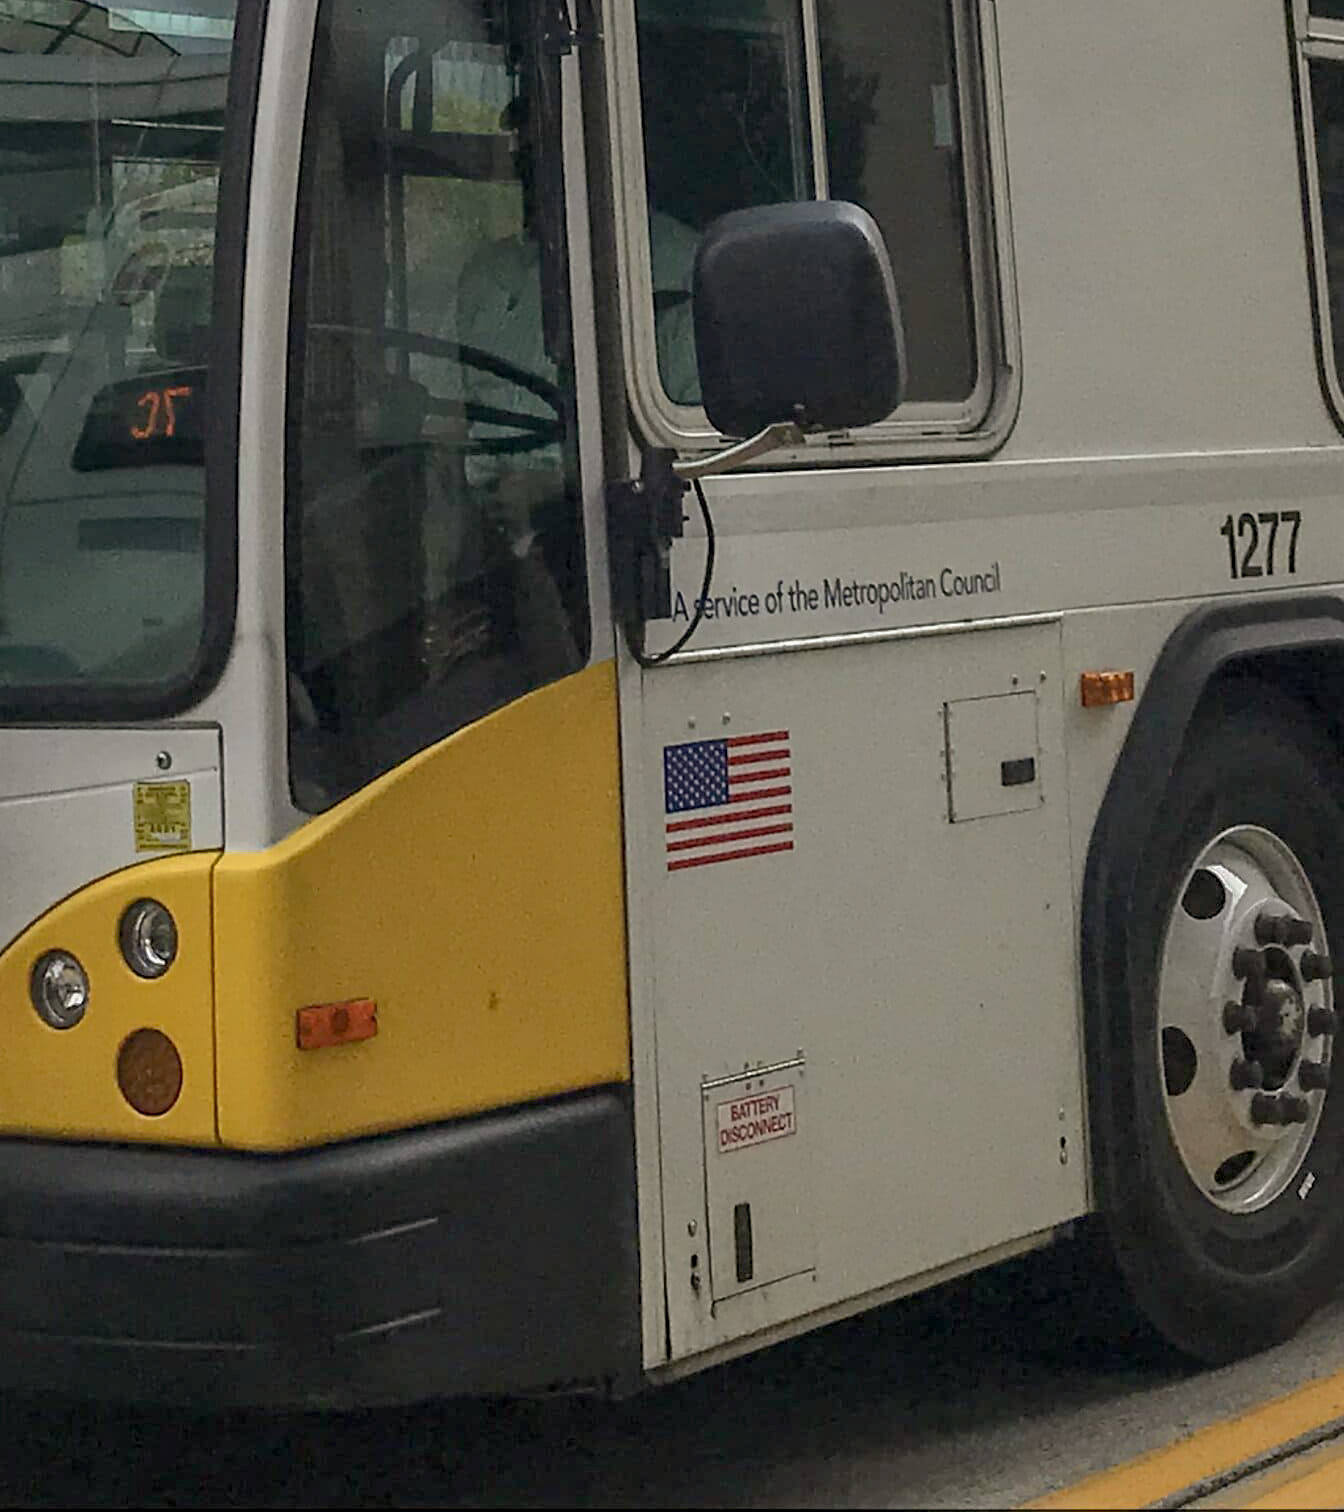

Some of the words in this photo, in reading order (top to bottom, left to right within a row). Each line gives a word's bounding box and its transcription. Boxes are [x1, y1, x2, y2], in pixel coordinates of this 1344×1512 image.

[1220, 510, 1301, 579] 1277
[671, 592, 689, 623] A
[765, 580, 785, 614] of
[787, 579, 820, 612] the
[822, 571, 937, 615] Metropolitan
[939, 561, 1002, 598] Council
[719, 1112, 793, 1147] DISCONNECT
[730, 1094, 781, 1122] BATTERY
